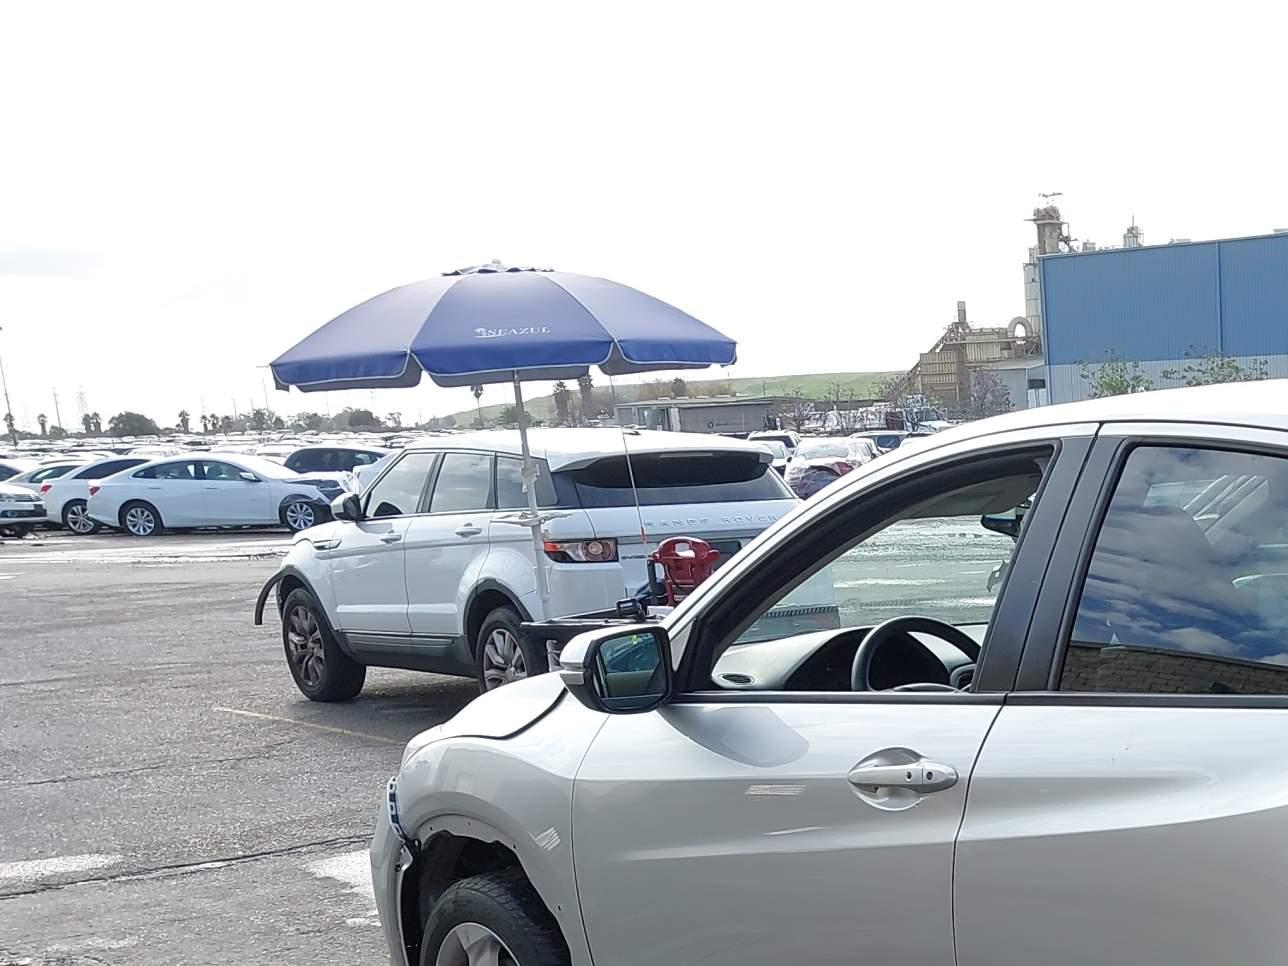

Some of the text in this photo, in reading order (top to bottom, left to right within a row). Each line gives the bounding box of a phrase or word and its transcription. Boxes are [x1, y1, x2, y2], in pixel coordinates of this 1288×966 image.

[486, 326, 552, 337] SEAZUL
[643, 513, 778, 528] RANGE ROVER
